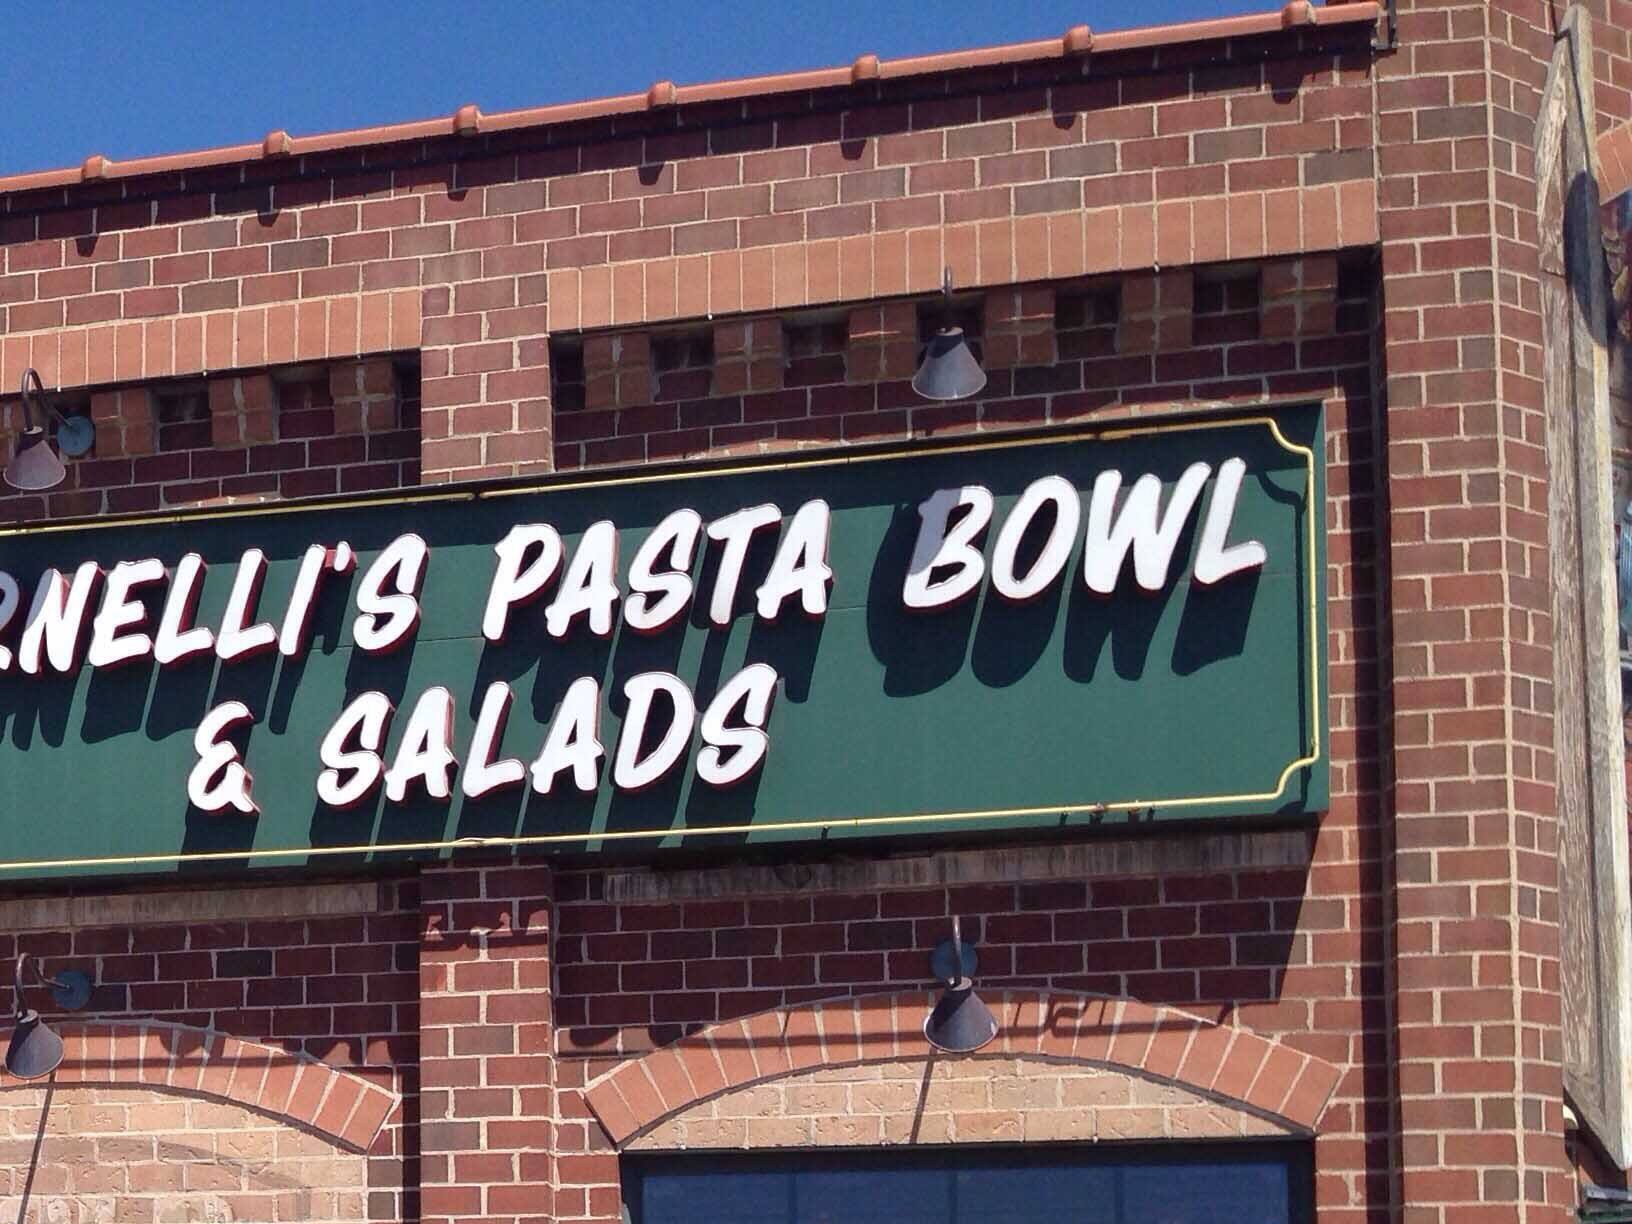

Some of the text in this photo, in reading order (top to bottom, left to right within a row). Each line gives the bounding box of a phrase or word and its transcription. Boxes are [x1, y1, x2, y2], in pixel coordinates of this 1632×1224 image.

[482, 498, 833, 642] PASTA
[903, 456, 1268, 609] BOWL
[186, 662, 780, 814] & SALADS
